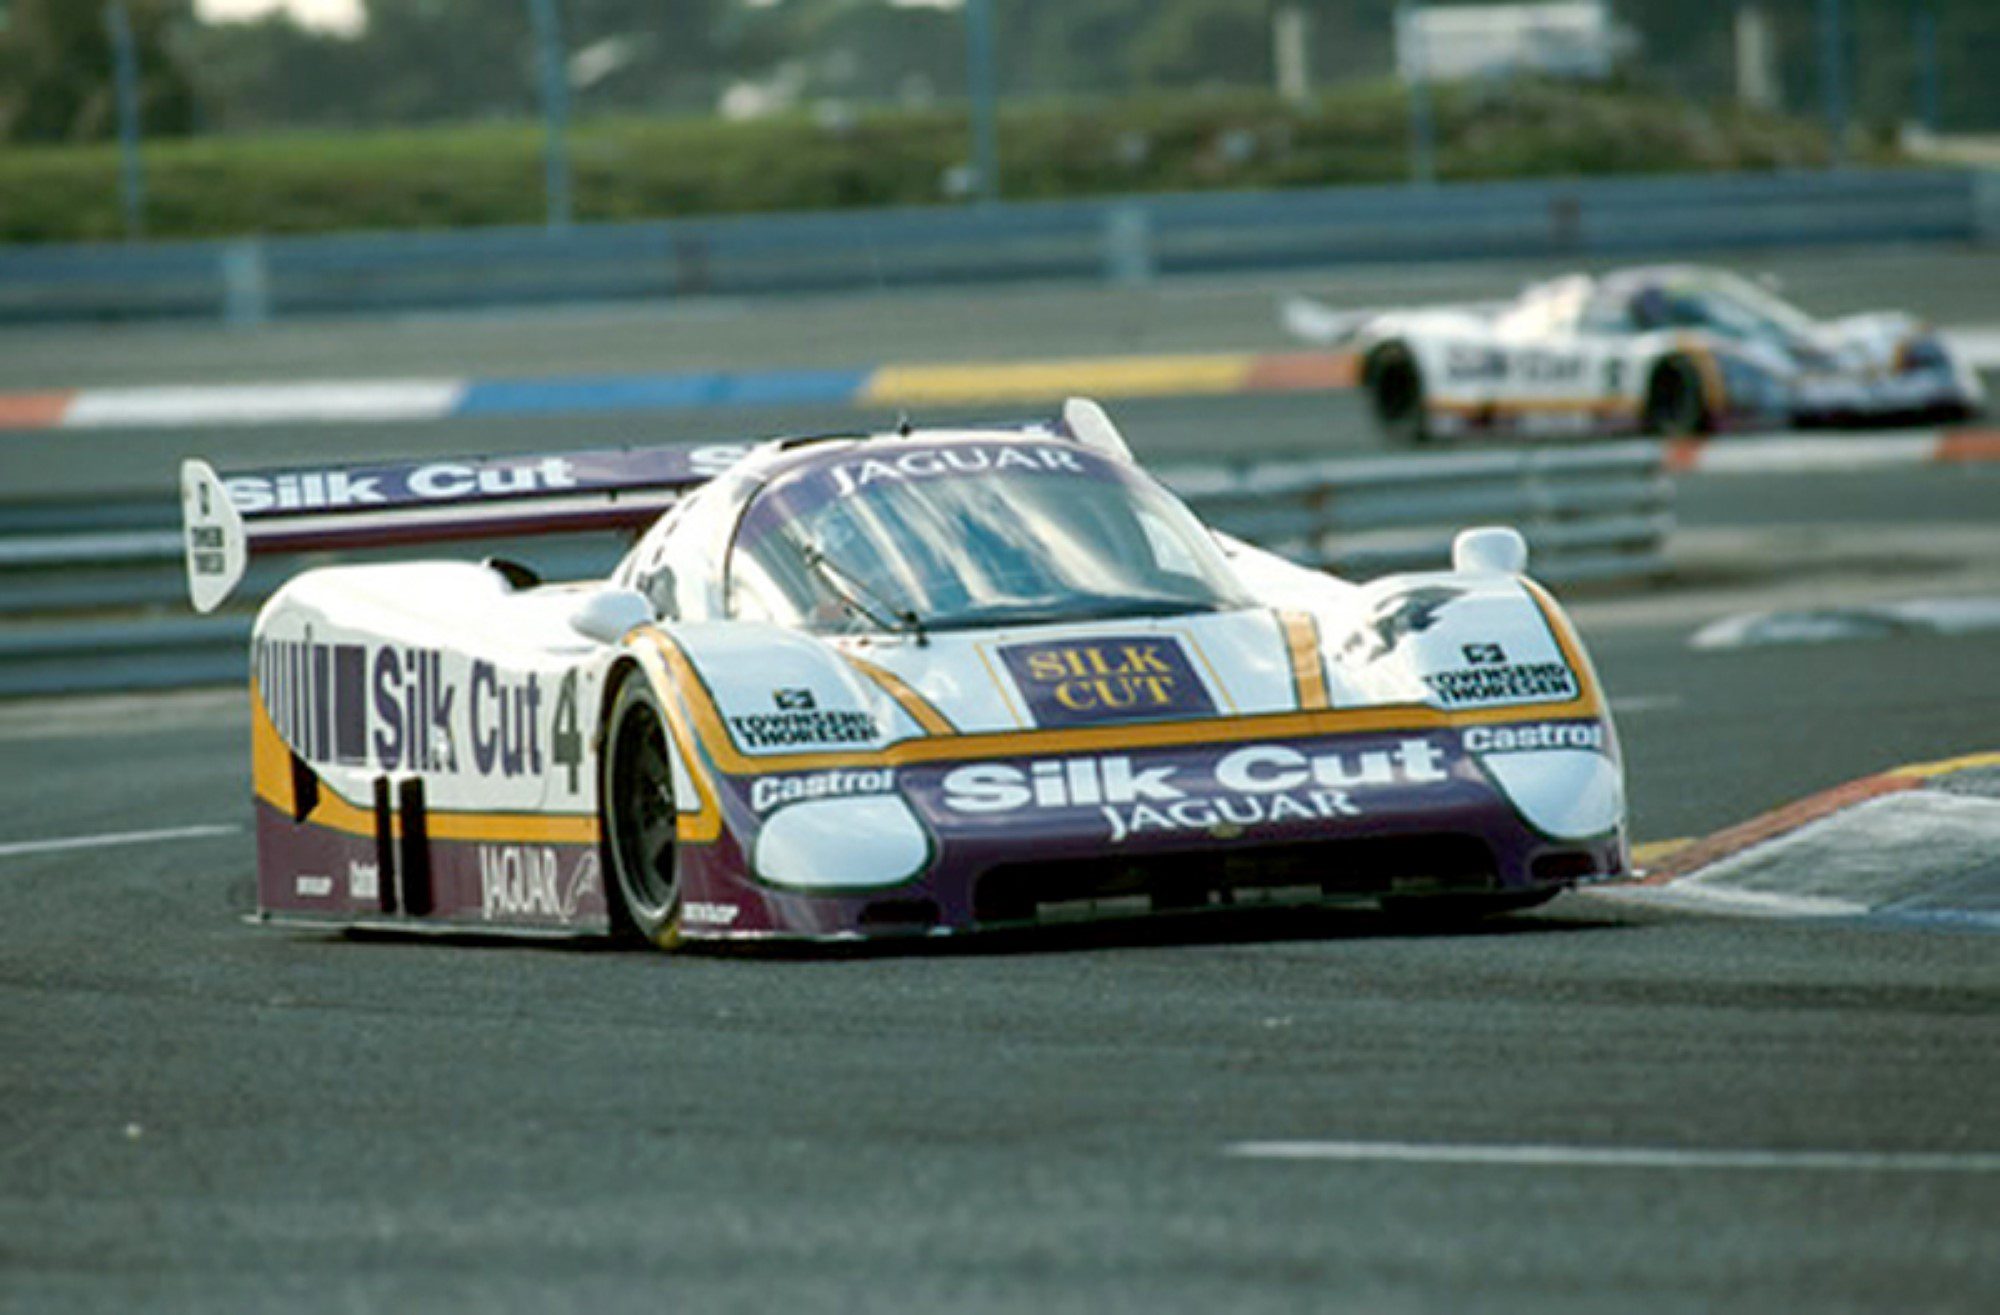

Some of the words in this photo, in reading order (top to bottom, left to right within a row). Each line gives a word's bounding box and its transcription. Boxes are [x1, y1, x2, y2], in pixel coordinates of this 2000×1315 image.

[224, 475, 386, 511] Silk
[407, 457, 575, 498] Cut
[829, 445, 1085, 498] JAGUAR
[1027, 644, 1170, 681] SILK
[1055, 675, 1177, 711] CUT
[371, 645, 458, 772] Silk
[470, 658, 544, 776] Cut
[551, 665, 583, 795] 4
[1462, 724, 1602, 751] Castrol
[751, 769, 896, 813] Castrol
[943, 756, 1183, 813] Silk
[1215, 739, 1448, 793] Cut
[1101, 788, 1362, 842] JAGUAR
[478, 844, 563, 922] JAGUAR
